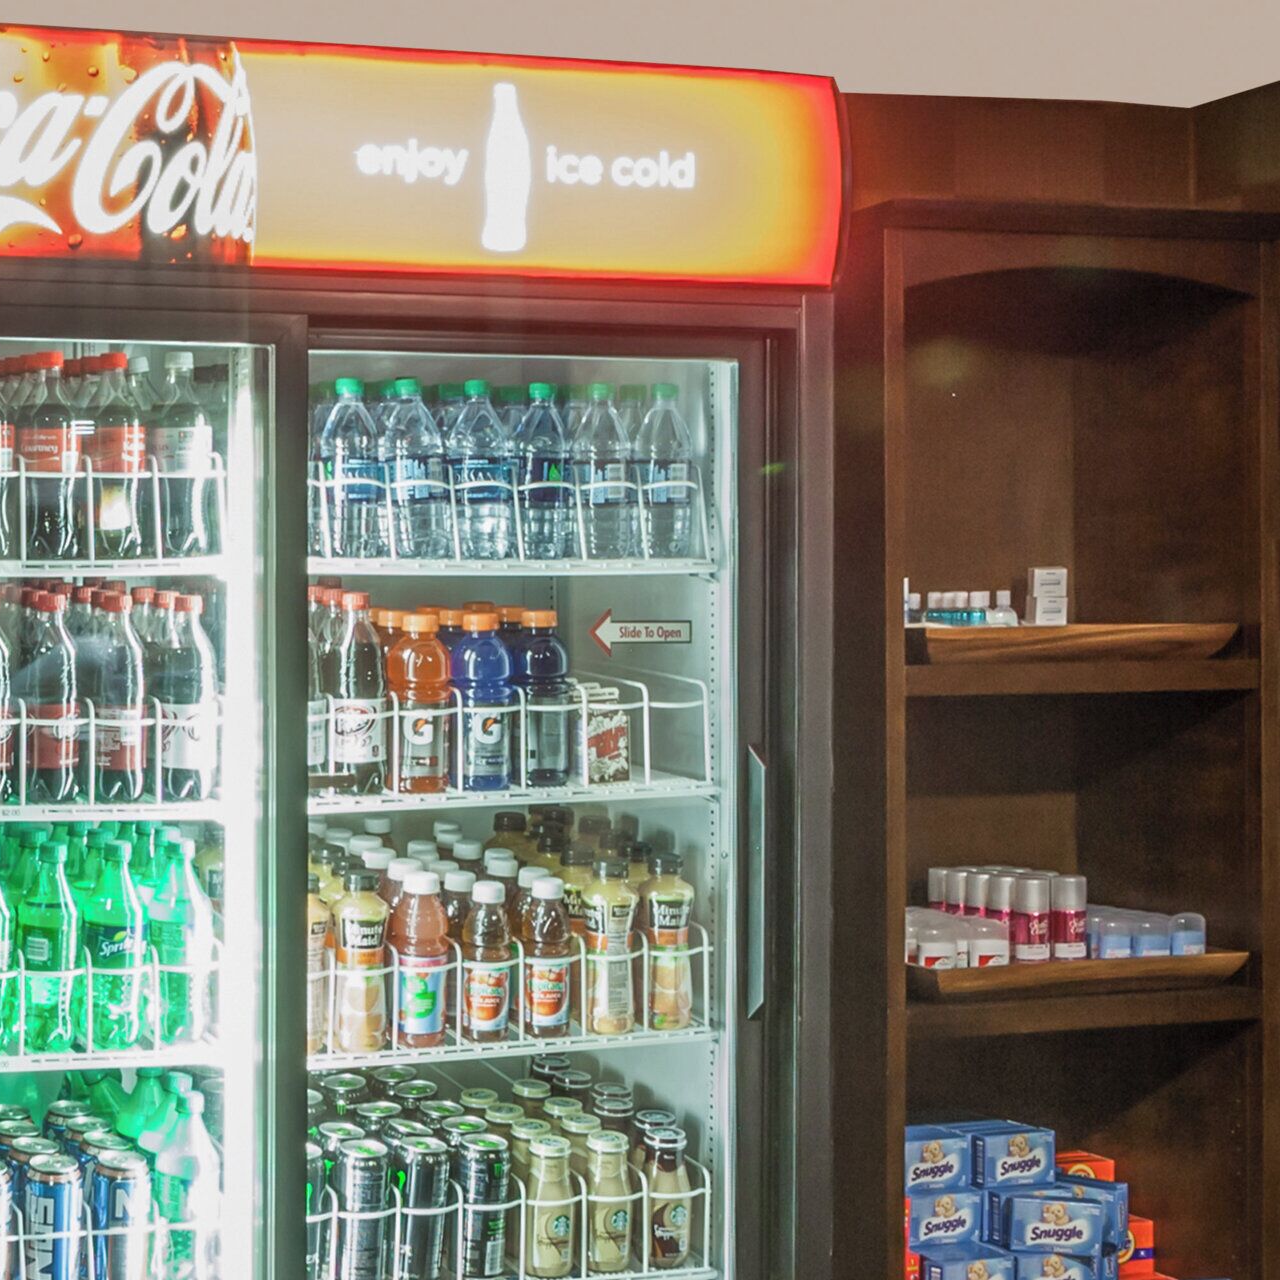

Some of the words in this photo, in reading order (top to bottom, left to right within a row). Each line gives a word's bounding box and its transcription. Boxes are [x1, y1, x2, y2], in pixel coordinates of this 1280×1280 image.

[356, 139, 469, 186] enjoy
[546, 145, 604, 185] ice
[611, 150, 695, 188] cold
[619, 626, 642, 638] Slide
[644, 626, 655, 638] To
[656, 626, 682, 642] Open
[911, 1161, 954, 1182] Snuggle
[1000, 1155, 1041, 1177] Snuggle
[923, 1216, 967, 1237] Snuggle
[1030, 1226, 1084, 1242] Snuggle
